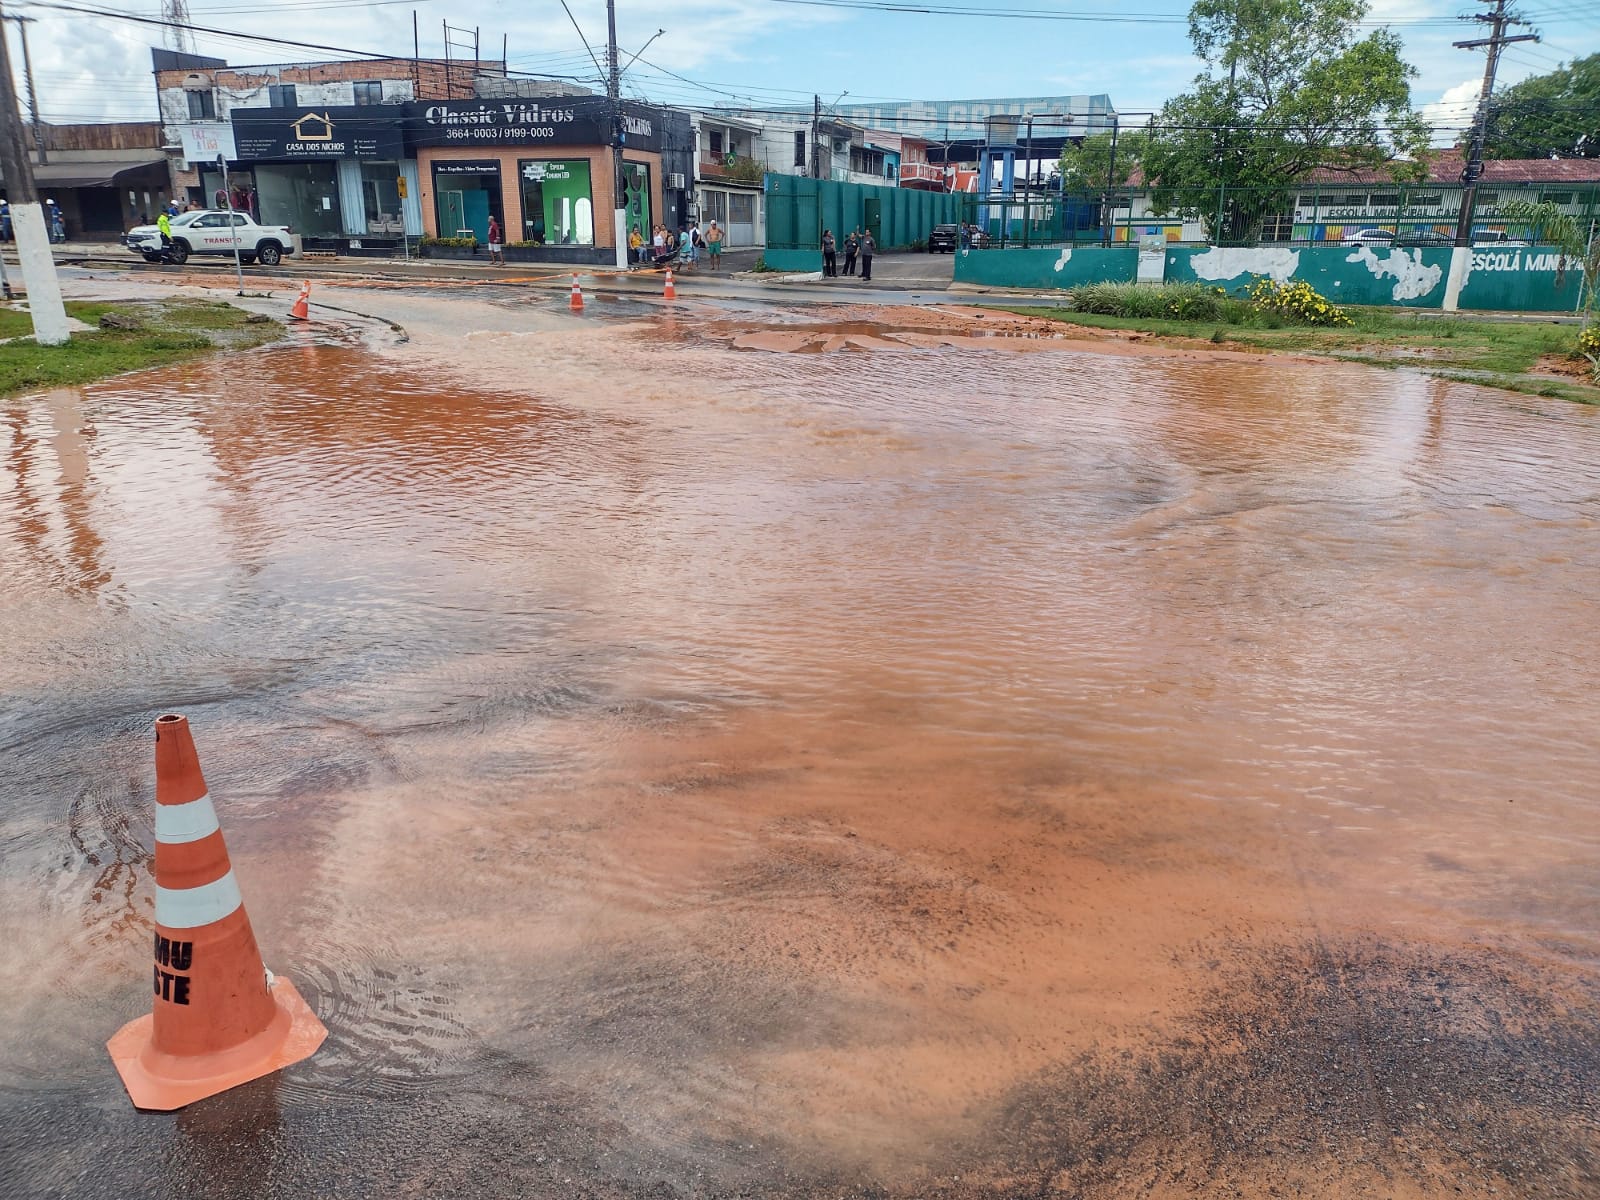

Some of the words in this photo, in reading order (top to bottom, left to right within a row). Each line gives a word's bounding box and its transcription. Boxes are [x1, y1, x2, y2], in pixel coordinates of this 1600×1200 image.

[425, 105, 497, 125] Classic
[503, 103, 574, 123] Vidros
[446, 128, 498, 139] 3664-0003
[504, 127, 554, 138] 9199-0003
[286, 143, 304, 151] CASA
[306, 143, 320, 151] DOS
[321, 142, 345, 151] NICHOS
[1374, 207, 1431, 218] MUNCIPAL
